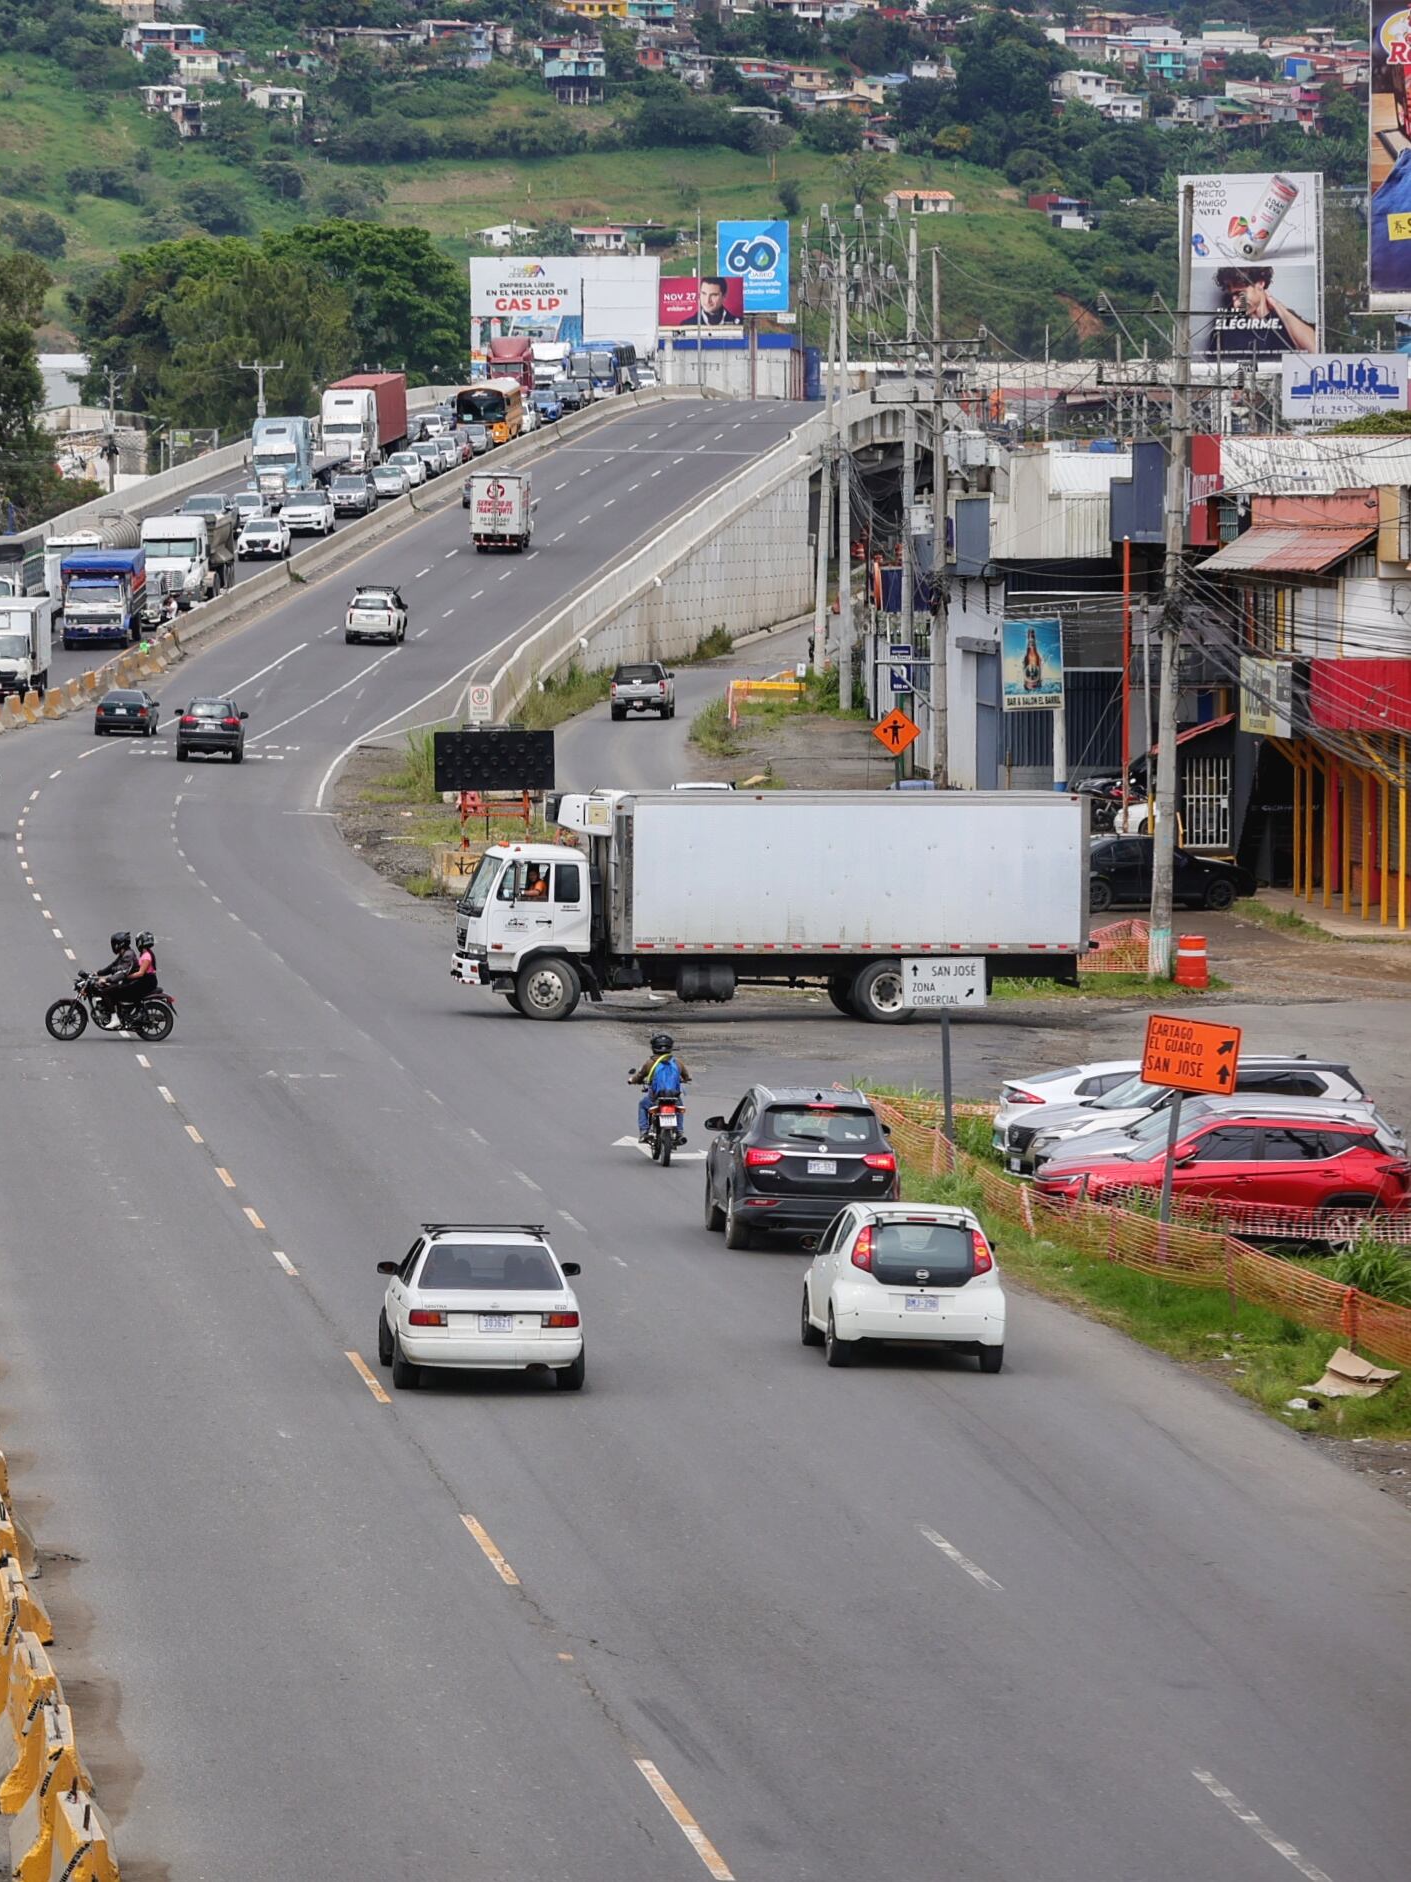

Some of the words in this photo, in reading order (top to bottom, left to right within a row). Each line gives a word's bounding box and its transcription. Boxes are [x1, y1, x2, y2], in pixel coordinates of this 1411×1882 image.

[727, 240, 777, 273] 60
[663, 293, 684, 301] NOV
[686, 292, 697, 300] 27
[495, 298, 532, 311] GAS
[538, 298, 560, 310] LP
[932, 965, 950, 976] SAN
[953, 963, 976, 976] JOSÉ
[912, 982, 935, 992] ZONA
[912, 995, 959, 1006] COMERCIAL
[1151, 1022, 1194, 1040] CARTAGO
[1149, 1036, 1160, 1050] EL
[1164, 1038, 1204, 1056] GUARCO
[1146, 1055, 1170, 1073] SAN
[1175, 1060, 1204, 1078] JOSE
